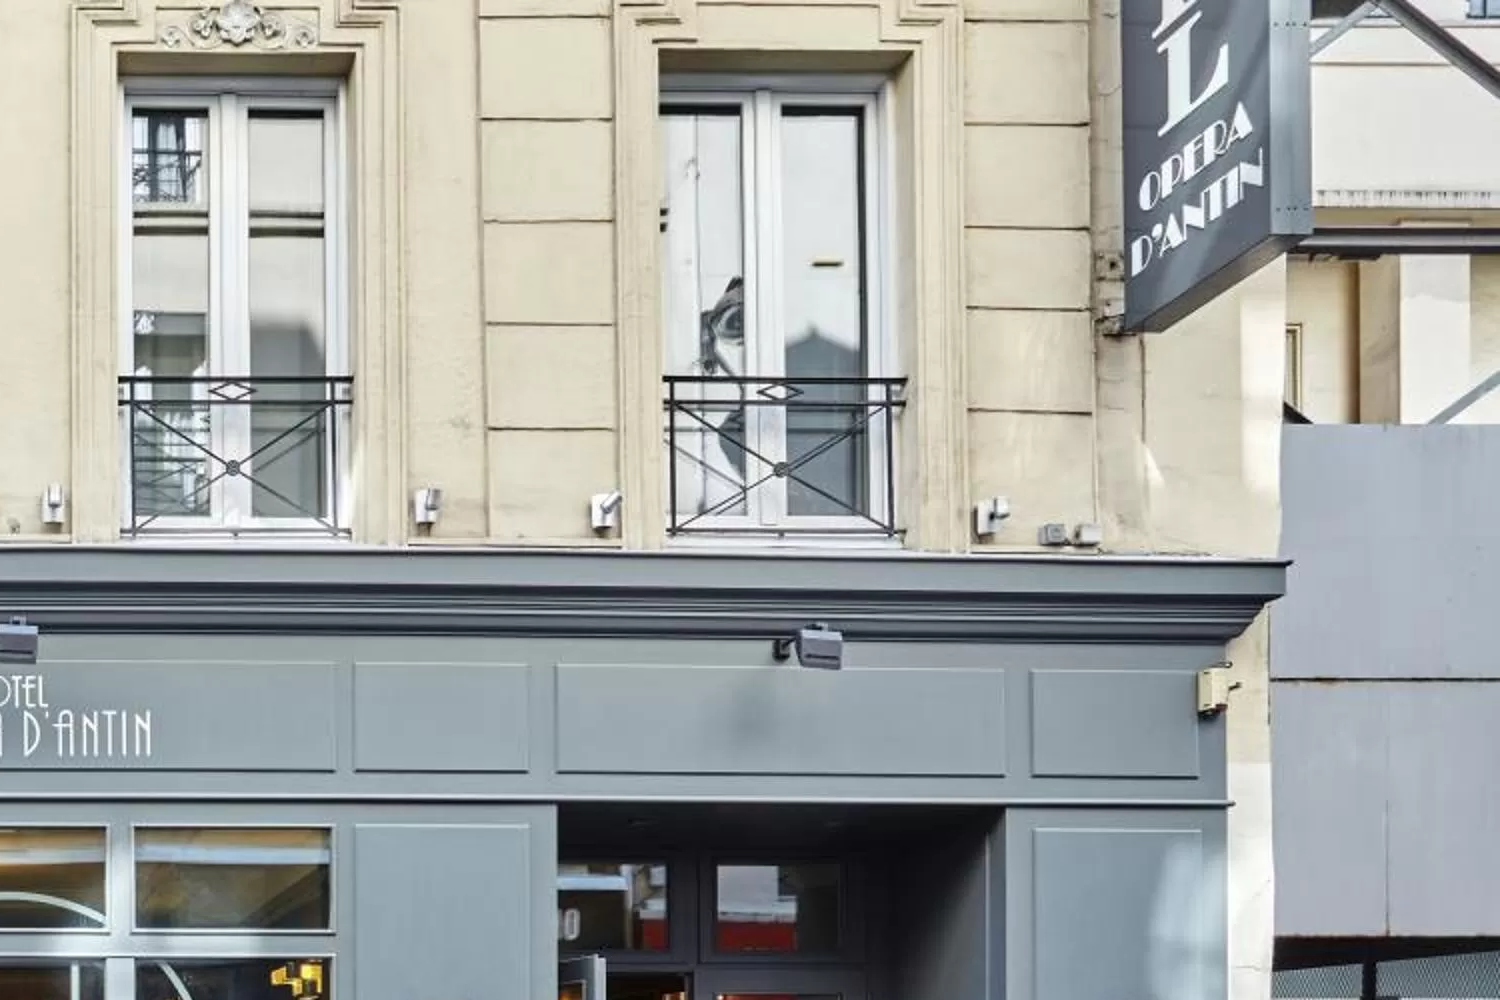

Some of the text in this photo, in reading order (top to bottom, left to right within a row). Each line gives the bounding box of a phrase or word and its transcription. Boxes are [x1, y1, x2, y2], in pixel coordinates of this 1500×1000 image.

[1139, 101, 1253, 211] OPERA
[1131, 147, 1265, 277] D'ANTIN
[22, 709, 153, 758] D'ANTIN
